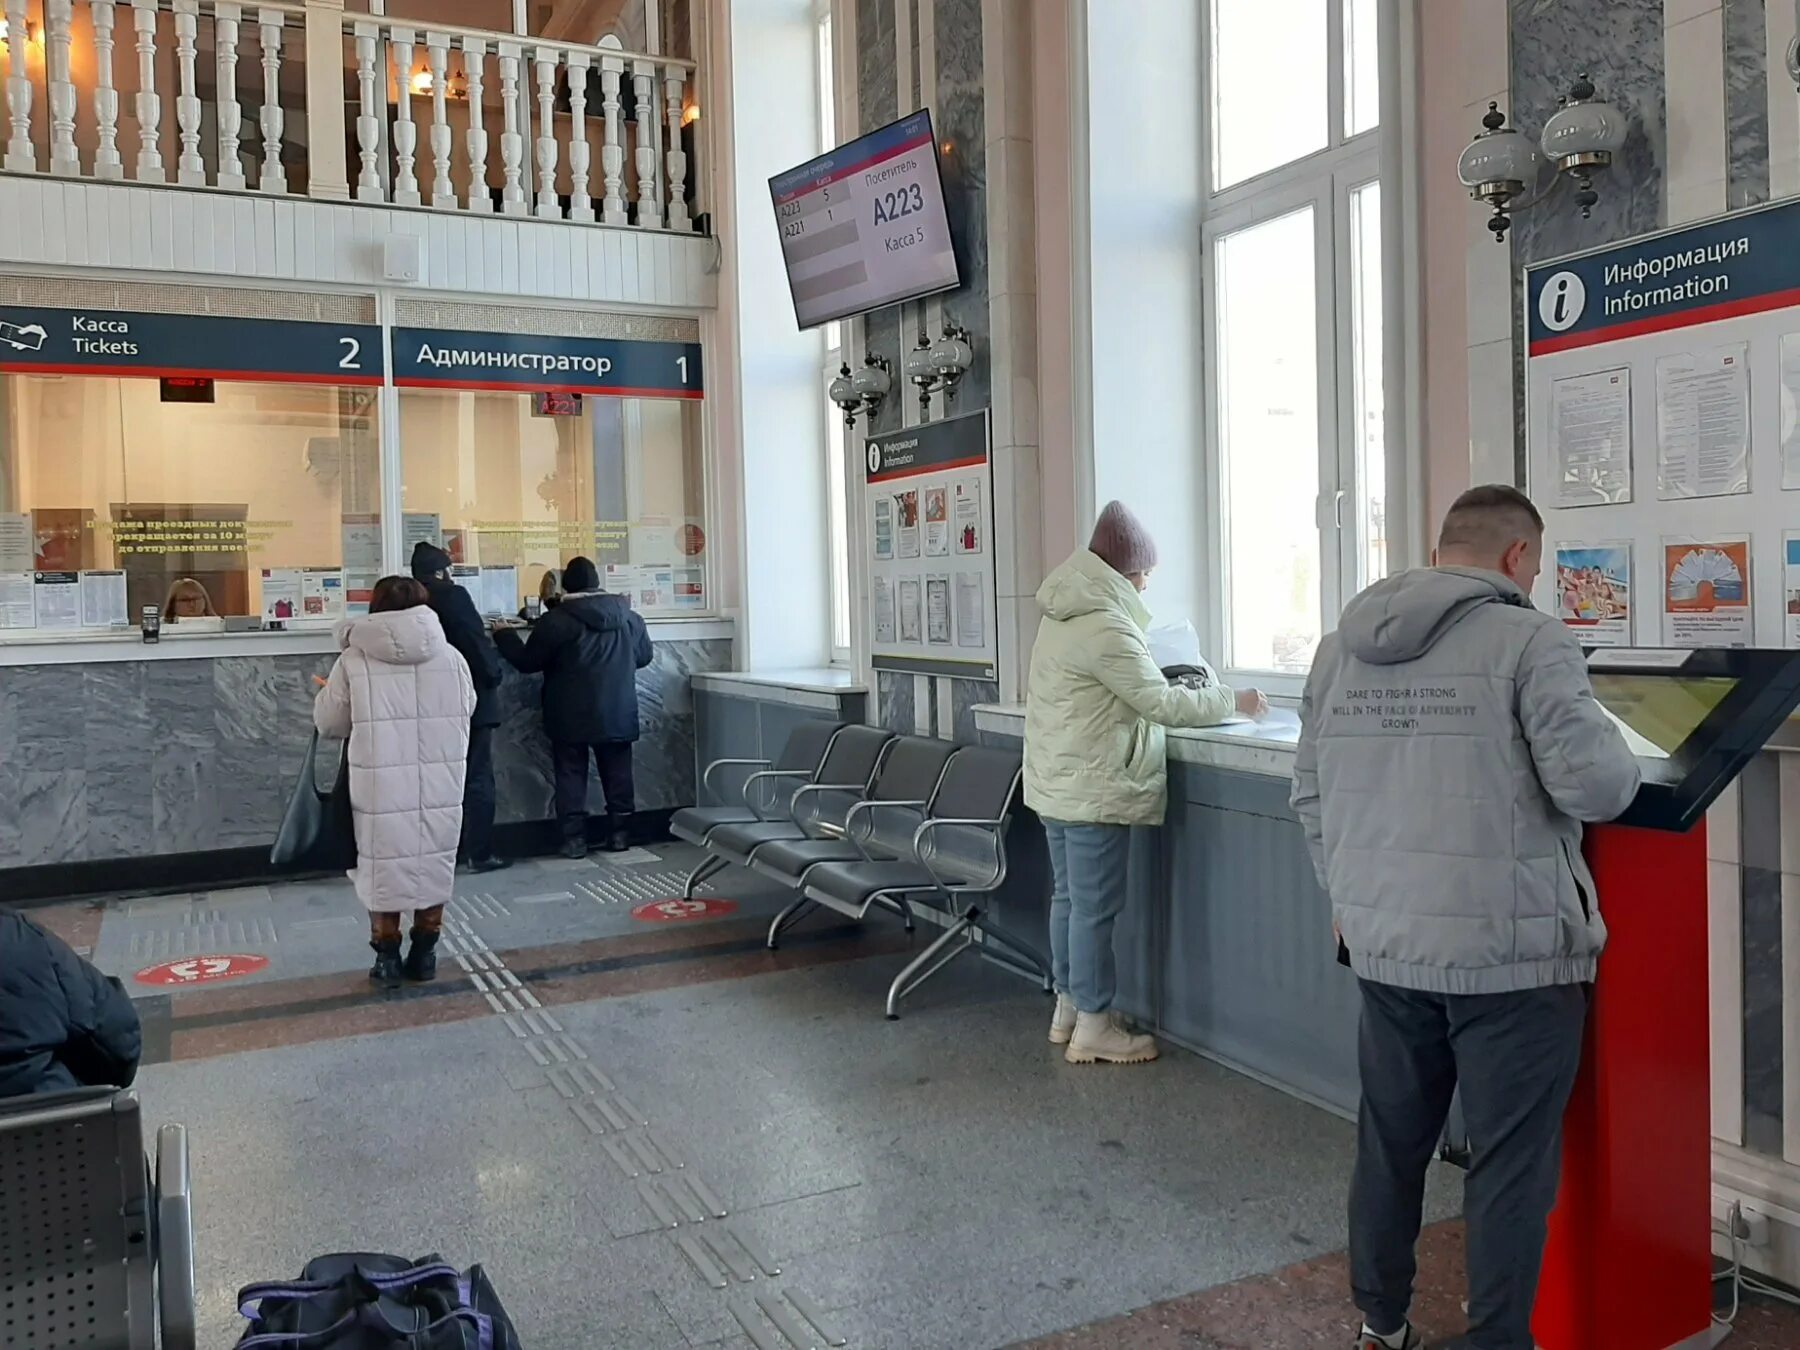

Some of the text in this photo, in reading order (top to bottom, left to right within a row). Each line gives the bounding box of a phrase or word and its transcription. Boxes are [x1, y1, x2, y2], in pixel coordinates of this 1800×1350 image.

[865, 159, 917, 187] Посетитель
[823, 189, 830, 202] 5
[827, 209, 833, 222] 1
[885, 227, 924, 253] Касса 5
[1604, 237, 1749, 286] Информация
[1605, 274, 1729, 316] Information
[72, 316, 129, 333] Касса
[72, 337, 139, 355] Tickets
[338, 336, 362, 369] 2
[416, 343, 688, 384] Администратор 1
[884, 439, 918, 453] Информация
[884, 455, 914, 467] Information
[86, 520, 144, 529] Пдажа
[146, 520, 217, 529] проездных
[136, 545, 218, 554] отправления
[1346, 689, 1368, 700] DARE
[1371, 689, 1383, 699] TO
[1420, 688, 1457, 699] STRONG
[1332, 706, 1351, 716] WILL
[1352, 706, 1363, 716] IN
[1366, 706, 1382, 716] THE
